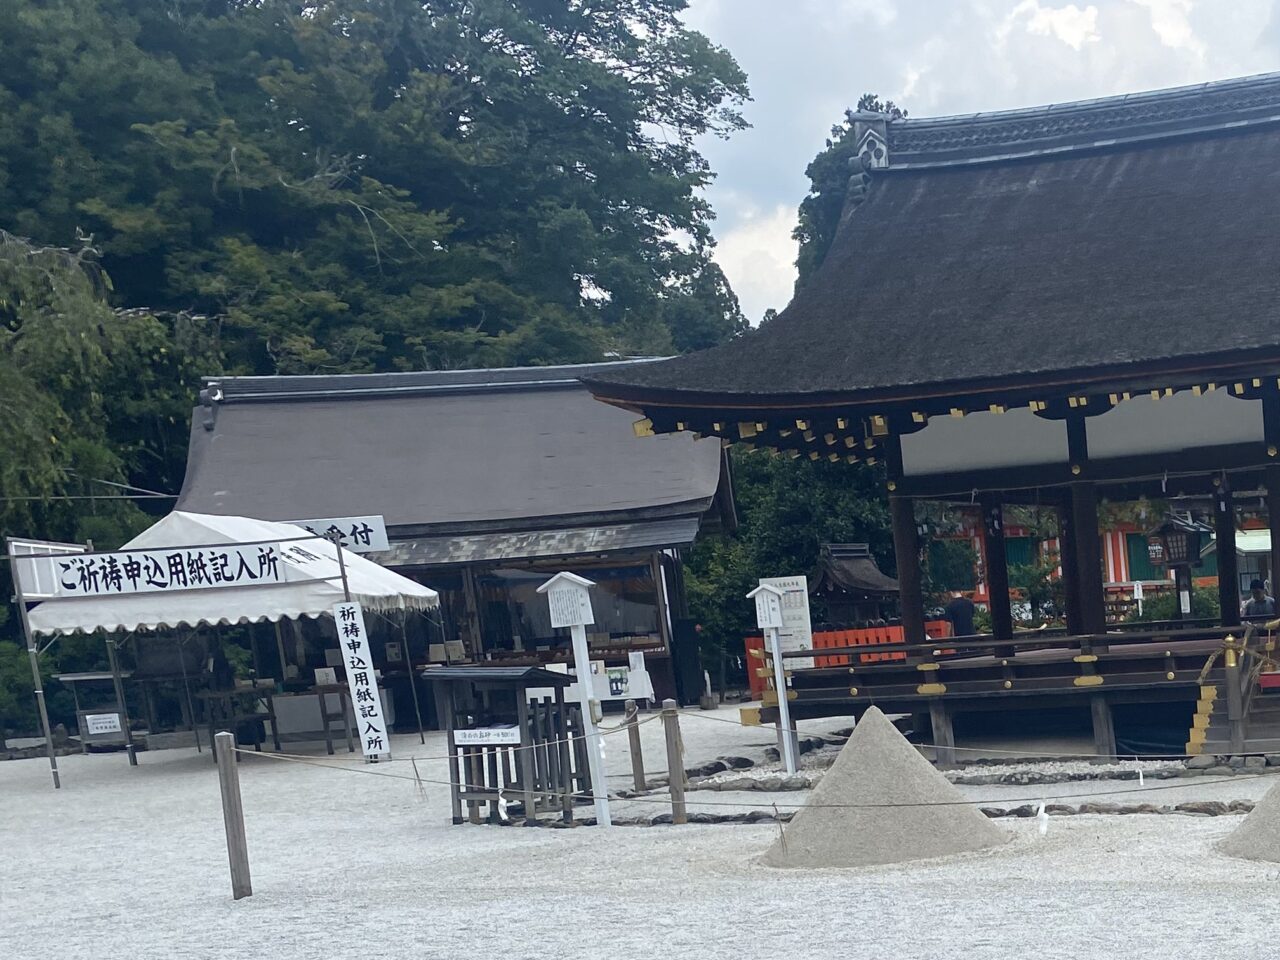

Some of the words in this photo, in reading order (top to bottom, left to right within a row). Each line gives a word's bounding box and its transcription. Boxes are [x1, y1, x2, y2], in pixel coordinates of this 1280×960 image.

[305, 522, 374, 547] 受付
[58, 547, 279, 593] ご祈祷申込用紙記入所
[339, 606, 383, 751] 祈祷申込用紙記入所
